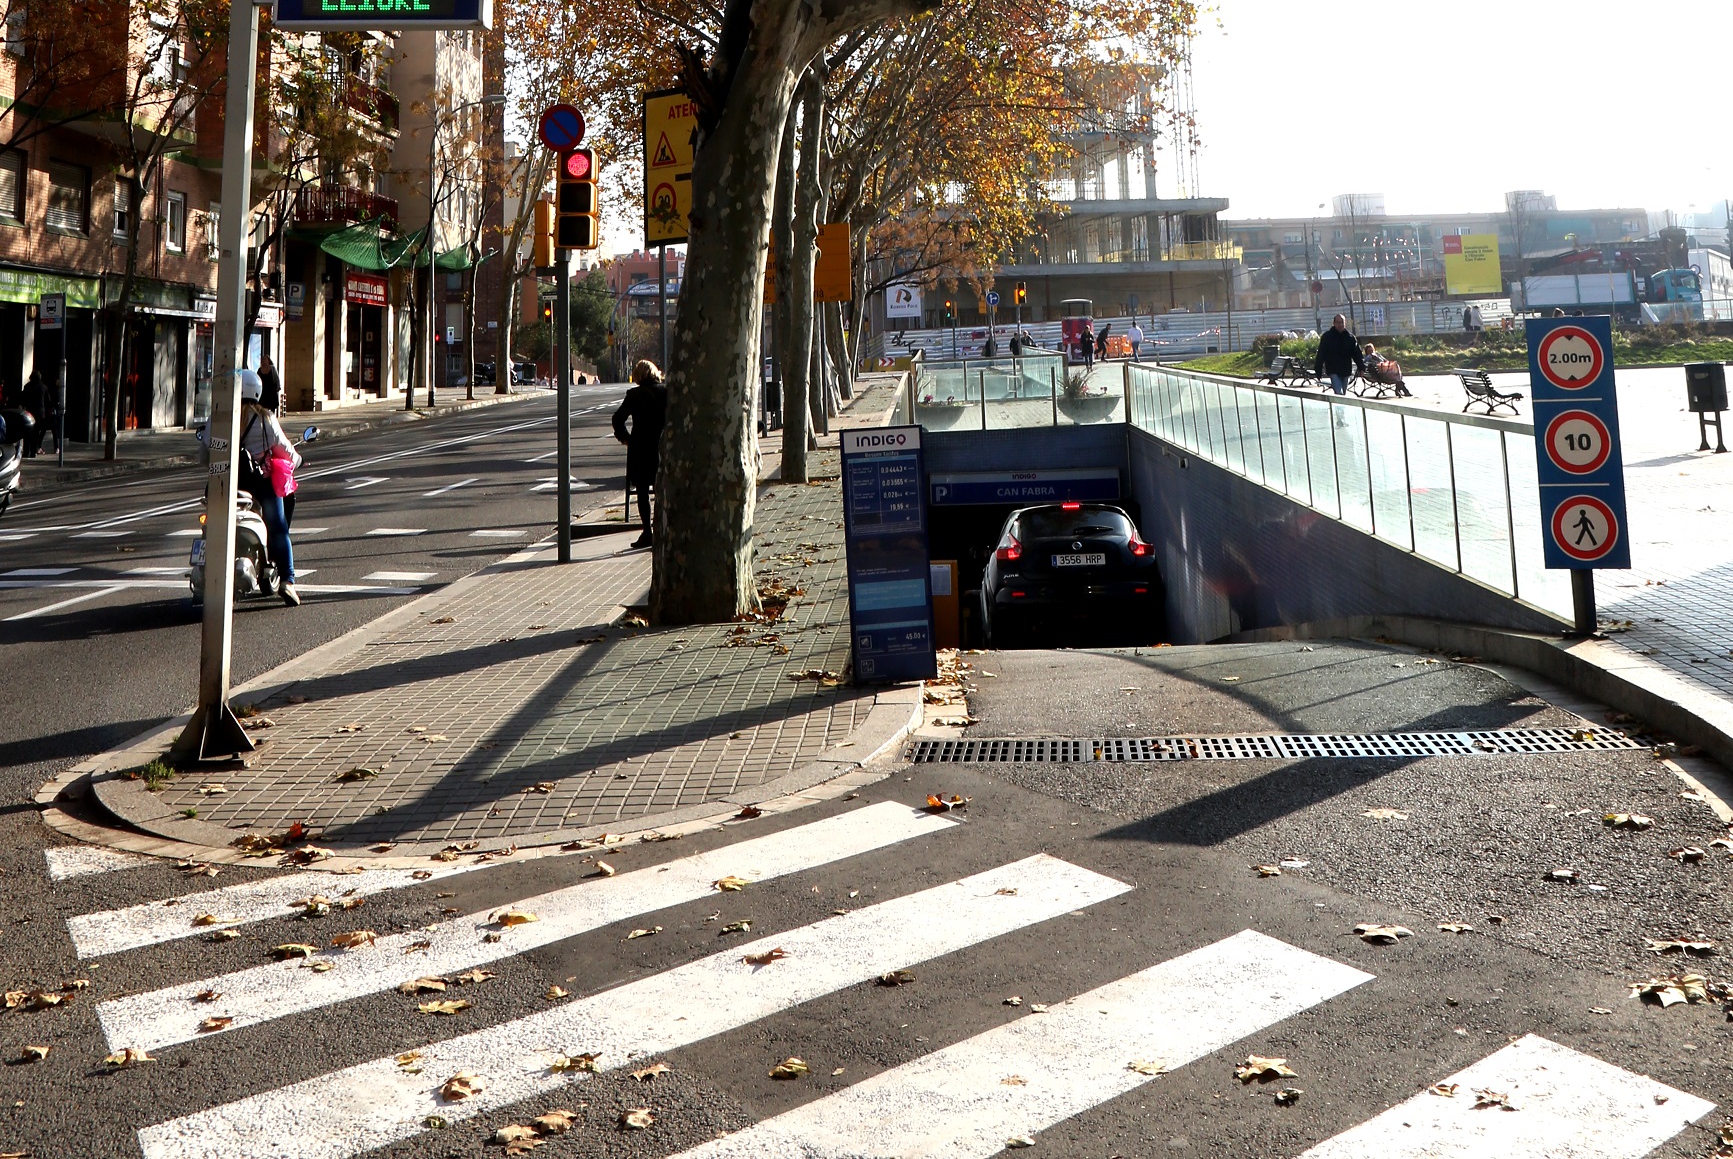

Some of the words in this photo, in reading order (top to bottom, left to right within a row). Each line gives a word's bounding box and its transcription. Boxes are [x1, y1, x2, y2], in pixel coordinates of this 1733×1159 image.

[290, 285, 299, 297] P
[1550, 353, 1592, 364] 2.00m
[856, 434, 906, 447] INDIGO
[1564, 433, 1592, 451] 10
[935, 486, 948, 502] P
[996, 487, 1020, 497] CAN
[1021, 486, 1056, 496] FABRA
[1059, 555, 1082, 565] 3556
[1085, 554, 1102, 564] HRP
